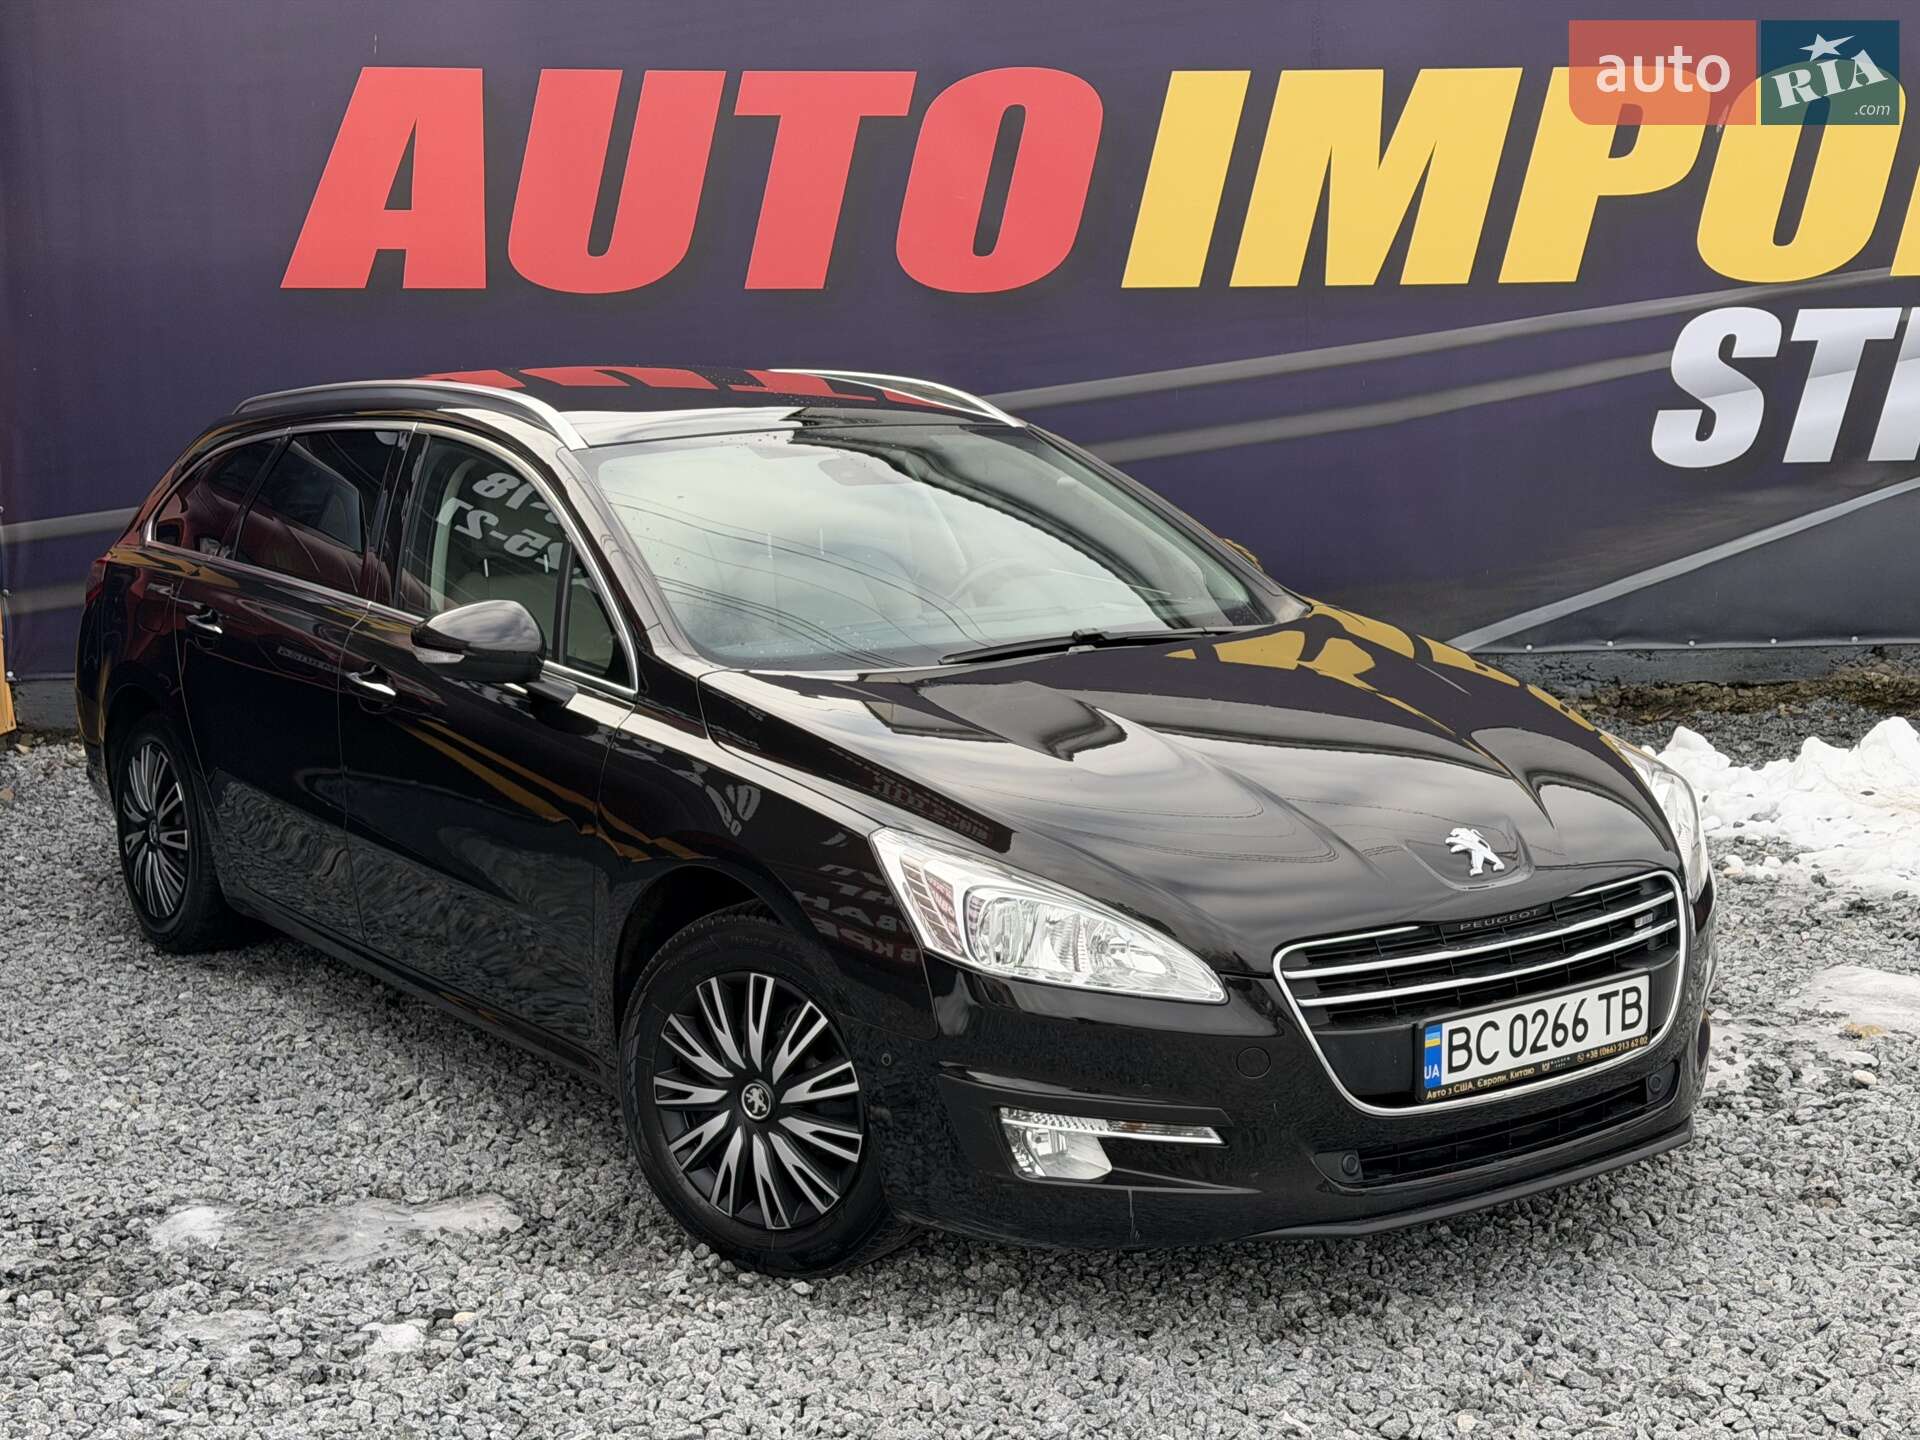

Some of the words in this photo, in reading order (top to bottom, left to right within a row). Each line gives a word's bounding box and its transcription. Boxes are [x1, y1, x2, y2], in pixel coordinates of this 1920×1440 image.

[281, 67, 1920, 294] AUTOIMPO
[1459, 908, 1539, 931] PEUGEOT
[1447, 1020, 1500, 1075] BC
[1509, 997, 1589, 1058] 0266
[1598, 986, 1642, 1036] TB
[1424, 1064, 1440, 1079] UA
[1427, 1089, 1446, 1099] Авто
[1510, 1067, 1535, 1079] Китаю
